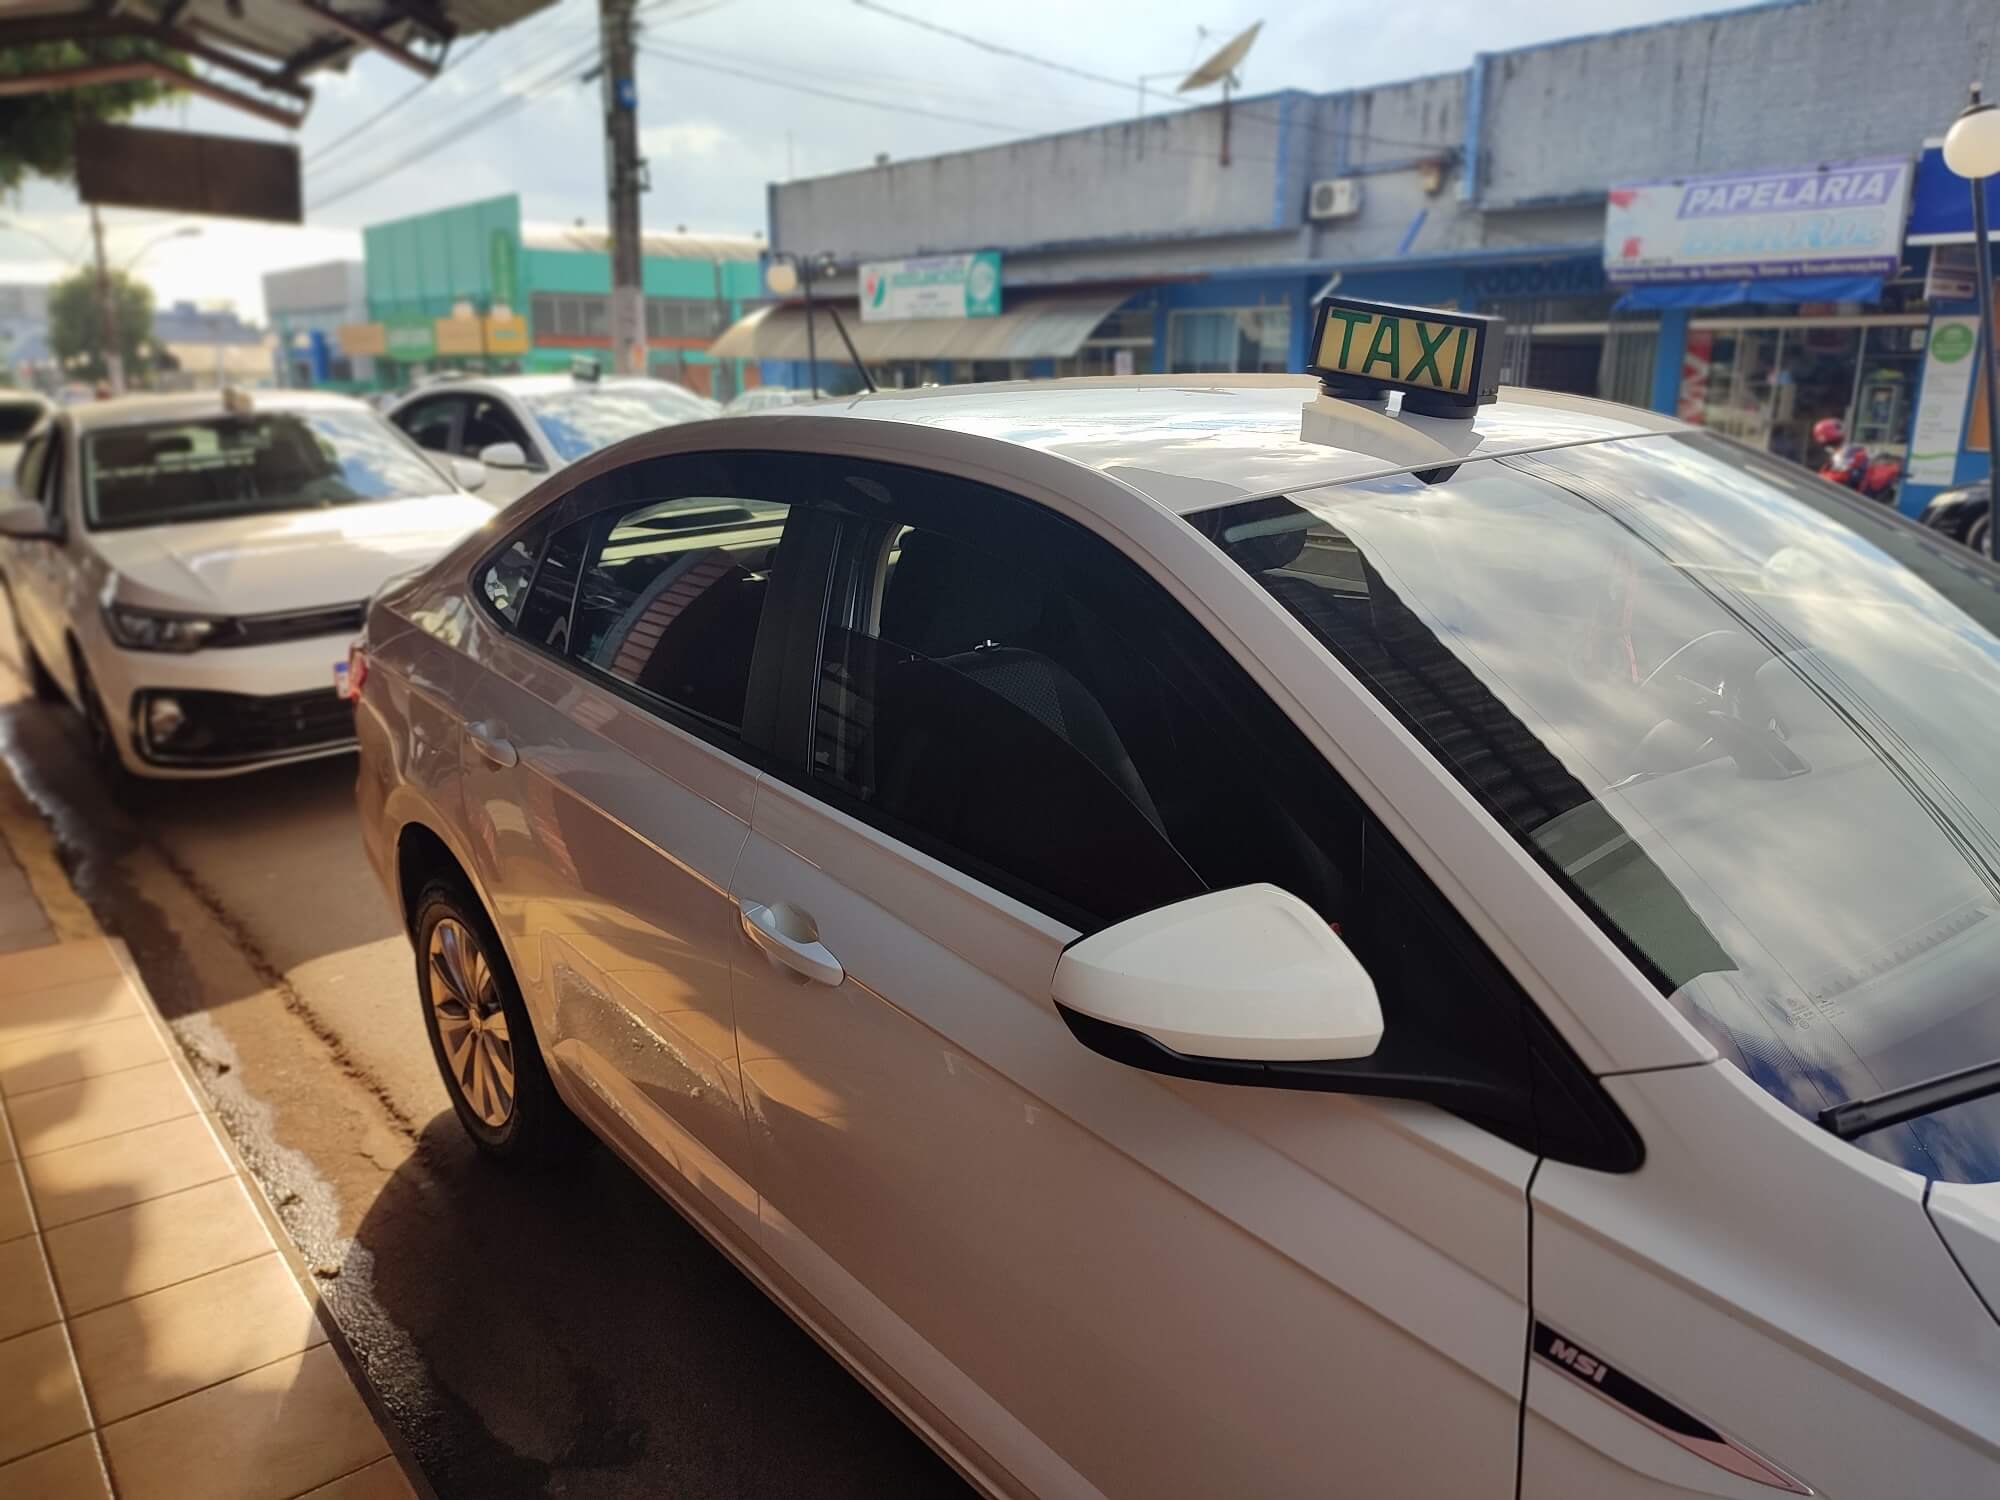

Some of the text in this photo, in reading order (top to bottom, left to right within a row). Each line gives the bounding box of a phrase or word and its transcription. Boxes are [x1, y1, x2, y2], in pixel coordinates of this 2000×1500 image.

[1686, 171, 1886, 213] PAPELARIA
[1331, 309, 1468, 390] TAXI
[1551, 1338, 1607, 1383] MSI
